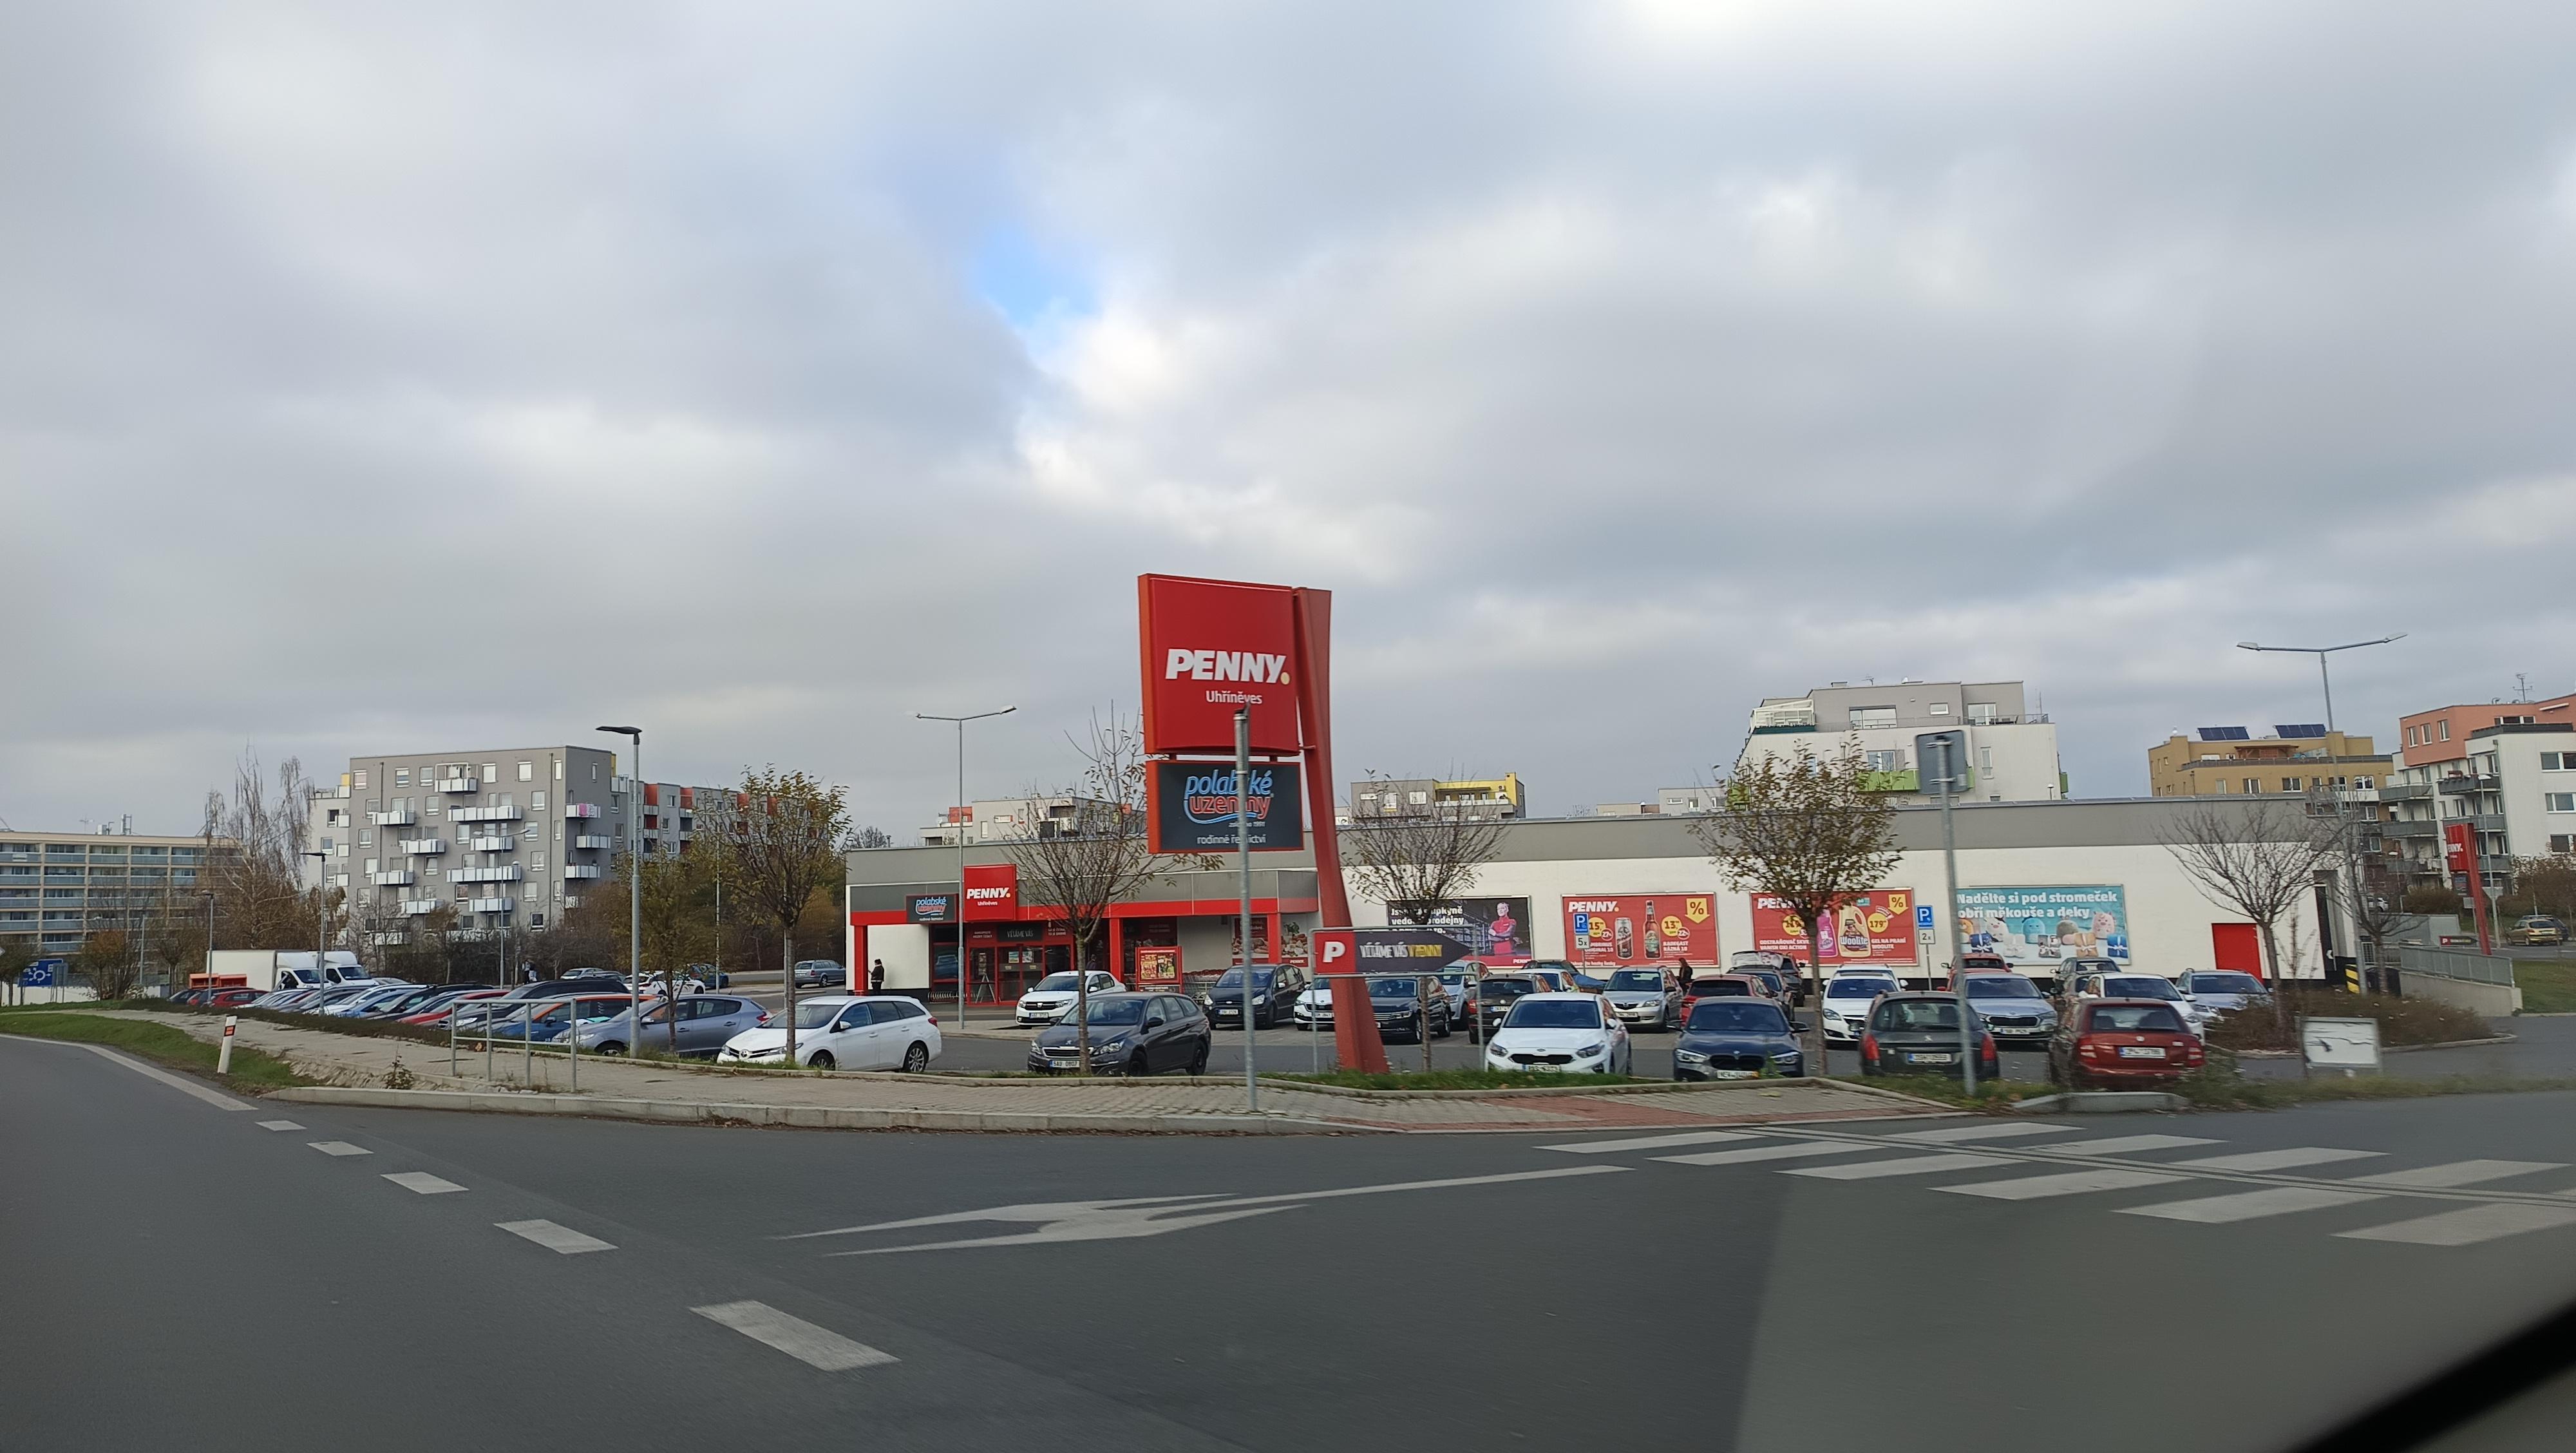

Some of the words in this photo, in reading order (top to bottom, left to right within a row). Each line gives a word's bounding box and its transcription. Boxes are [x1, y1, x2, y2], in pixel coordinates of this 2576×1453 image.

[1166, 649, 1290, 685] PENNY.
[1206, 690, 1262, 705] Uhříněves
[1184, 769, 1273, 799] polabké
[1189, 796, 1271, 819] uzenny
[1231, 834, 1266, 844] řeictví
[967, 888, 1011, 899] PENNY.
[1957, 892, 2005, 904] Nadělte
[2009, 892, 2020, 902] si
[2022, 892, 2046, 905] pod
[2049, 891, 2117, 902] stromeček
[916, 896, 947, 906] polabské
[1568, 901, 1619, 913] PENNY.
[1919, 909, 1929, 921] P
[1958, 907, 1983, 918] obří
[1986, 907, 2043, 918] měkouše
[2047, 909, 2054, 918] a
[2058, 907, 2090, 920] deky
[1576, 915, 1586, 927] P
[1840, 936, 1868, 945] Woolite
[1323, 941, 1345, 963] P
